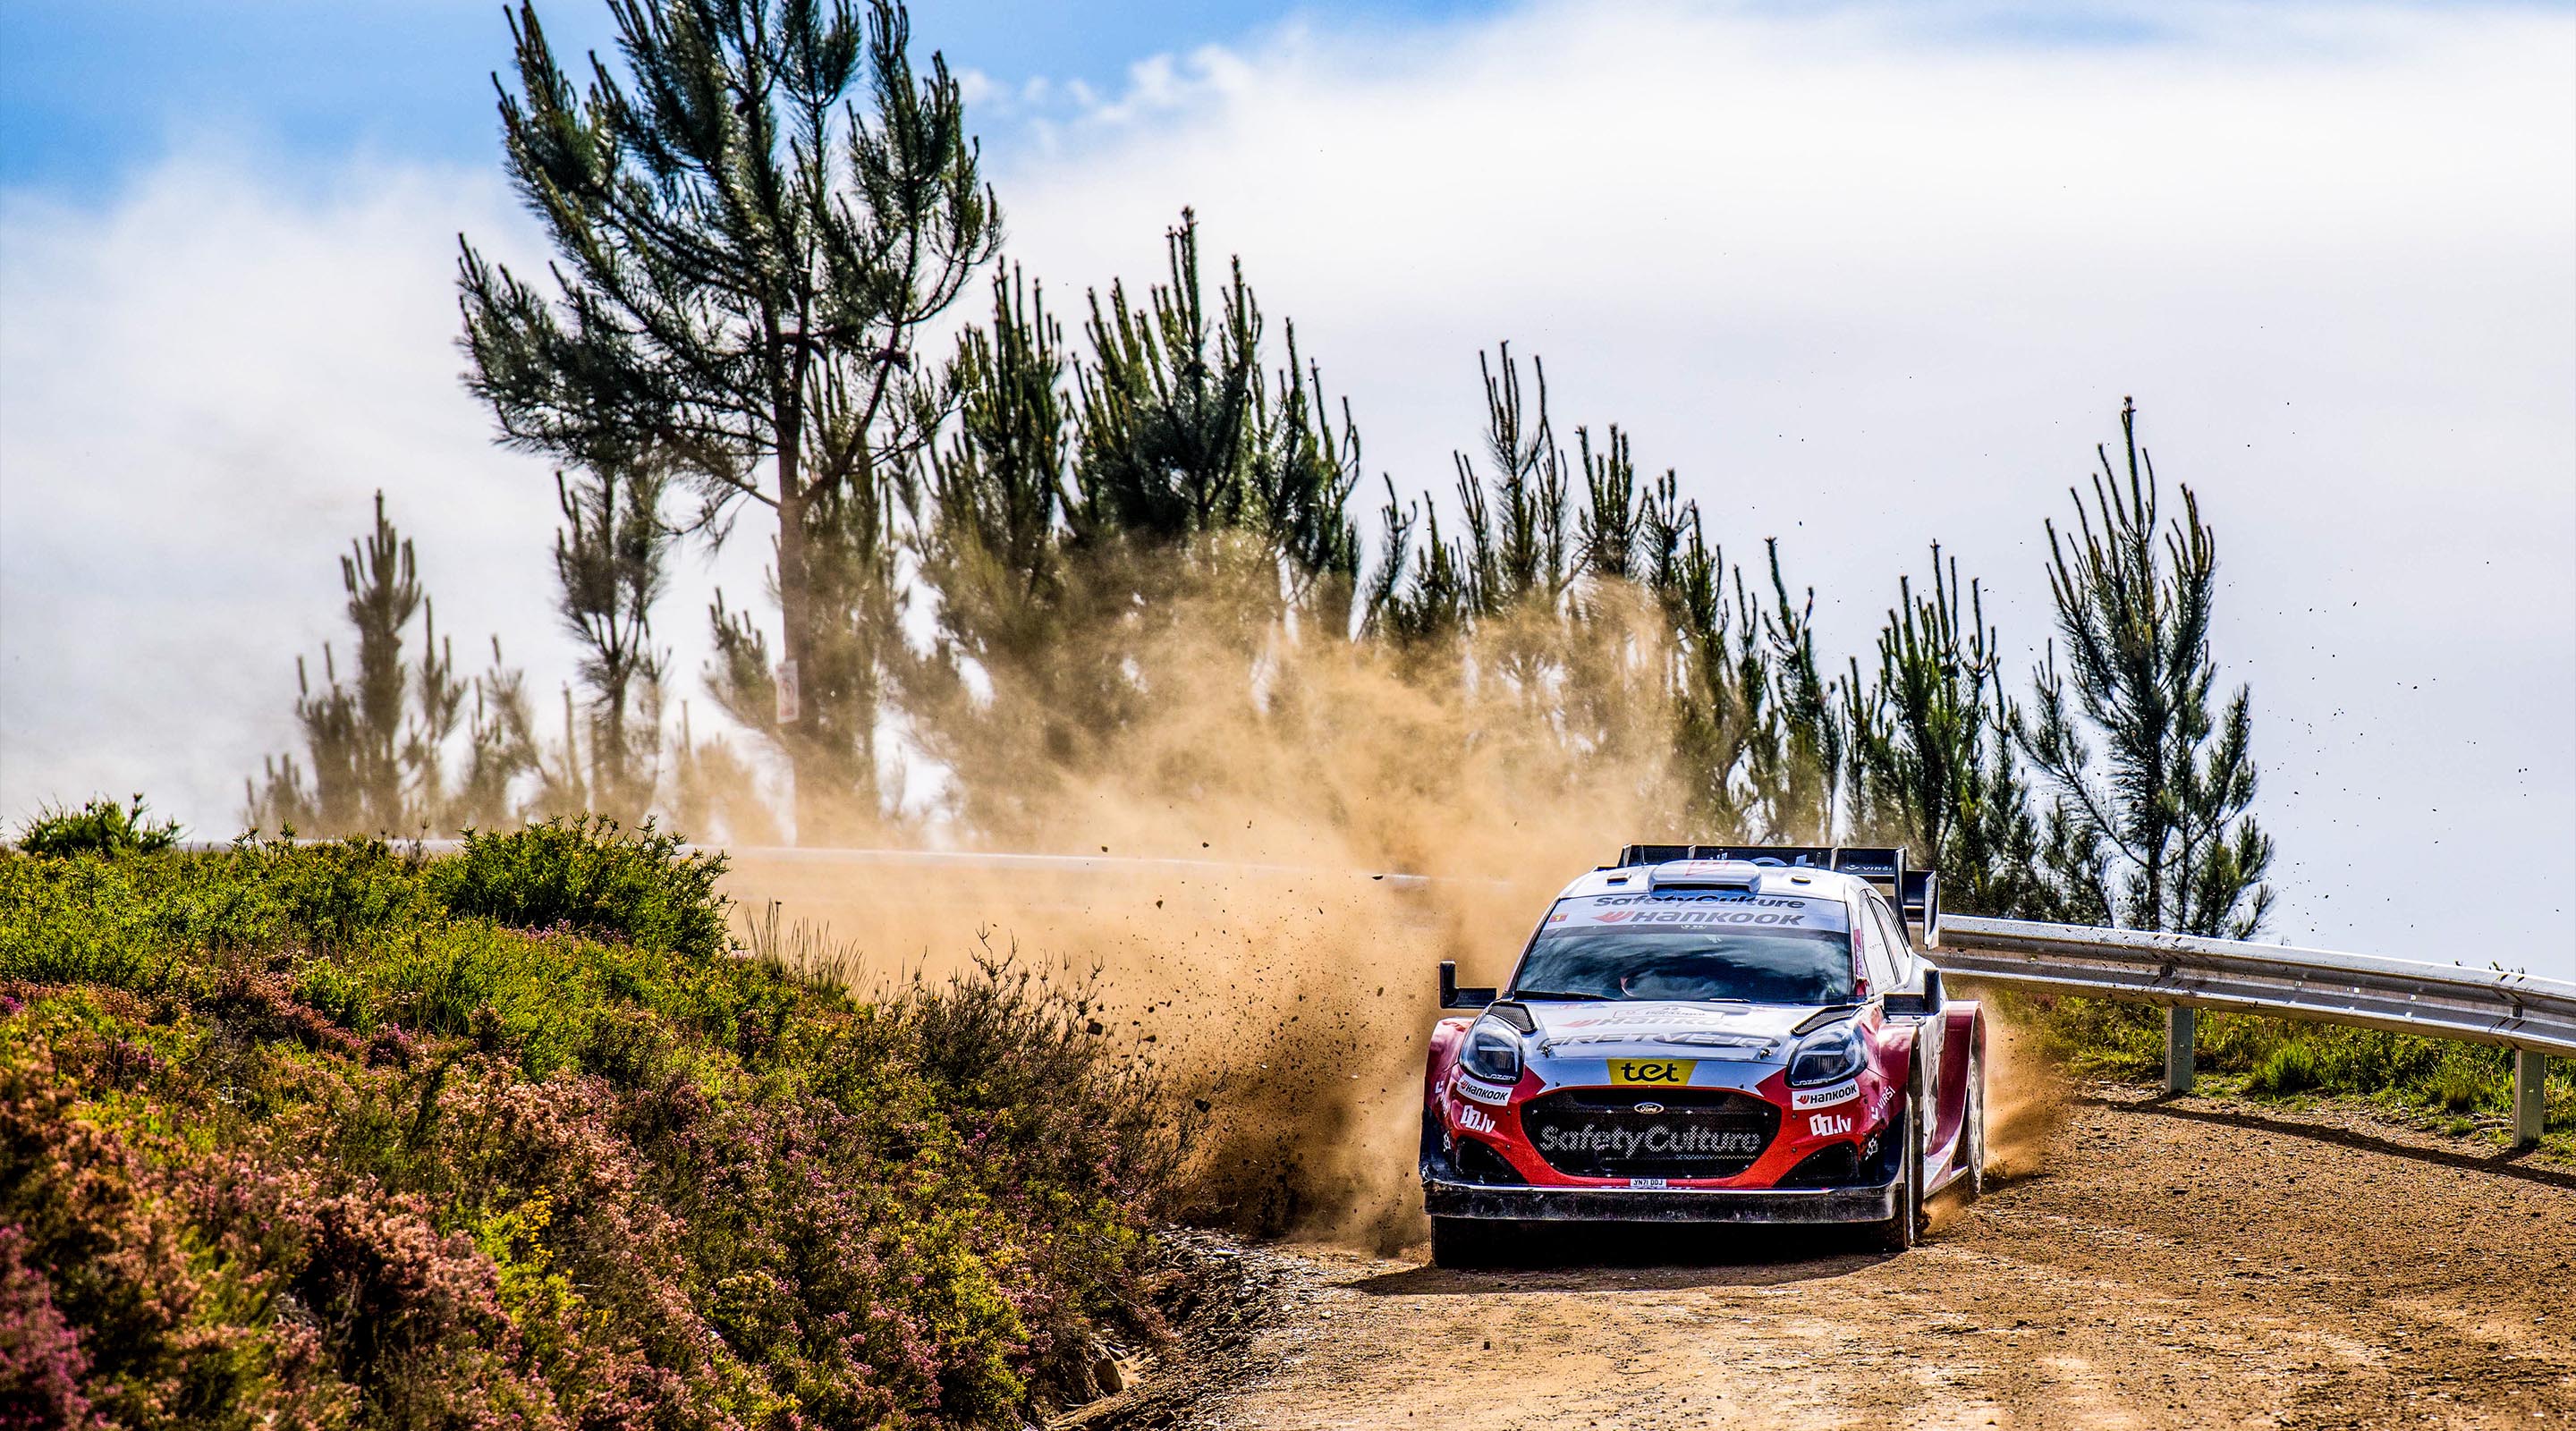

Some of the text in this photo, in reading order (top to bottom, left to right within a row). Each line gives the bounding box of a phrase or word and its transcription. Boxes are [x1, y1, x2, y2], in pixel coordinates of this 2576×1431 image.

[1593, 894, 1805, 910] SafetyCulture
[1621, 1062, 1679, 1082] tet
[1877, 1086, 1895, 1109] VIRŠI
[1639, 1103, 1659, 1113] Ford
[1539, 1123, 1760, 1158] SafetyCulture
